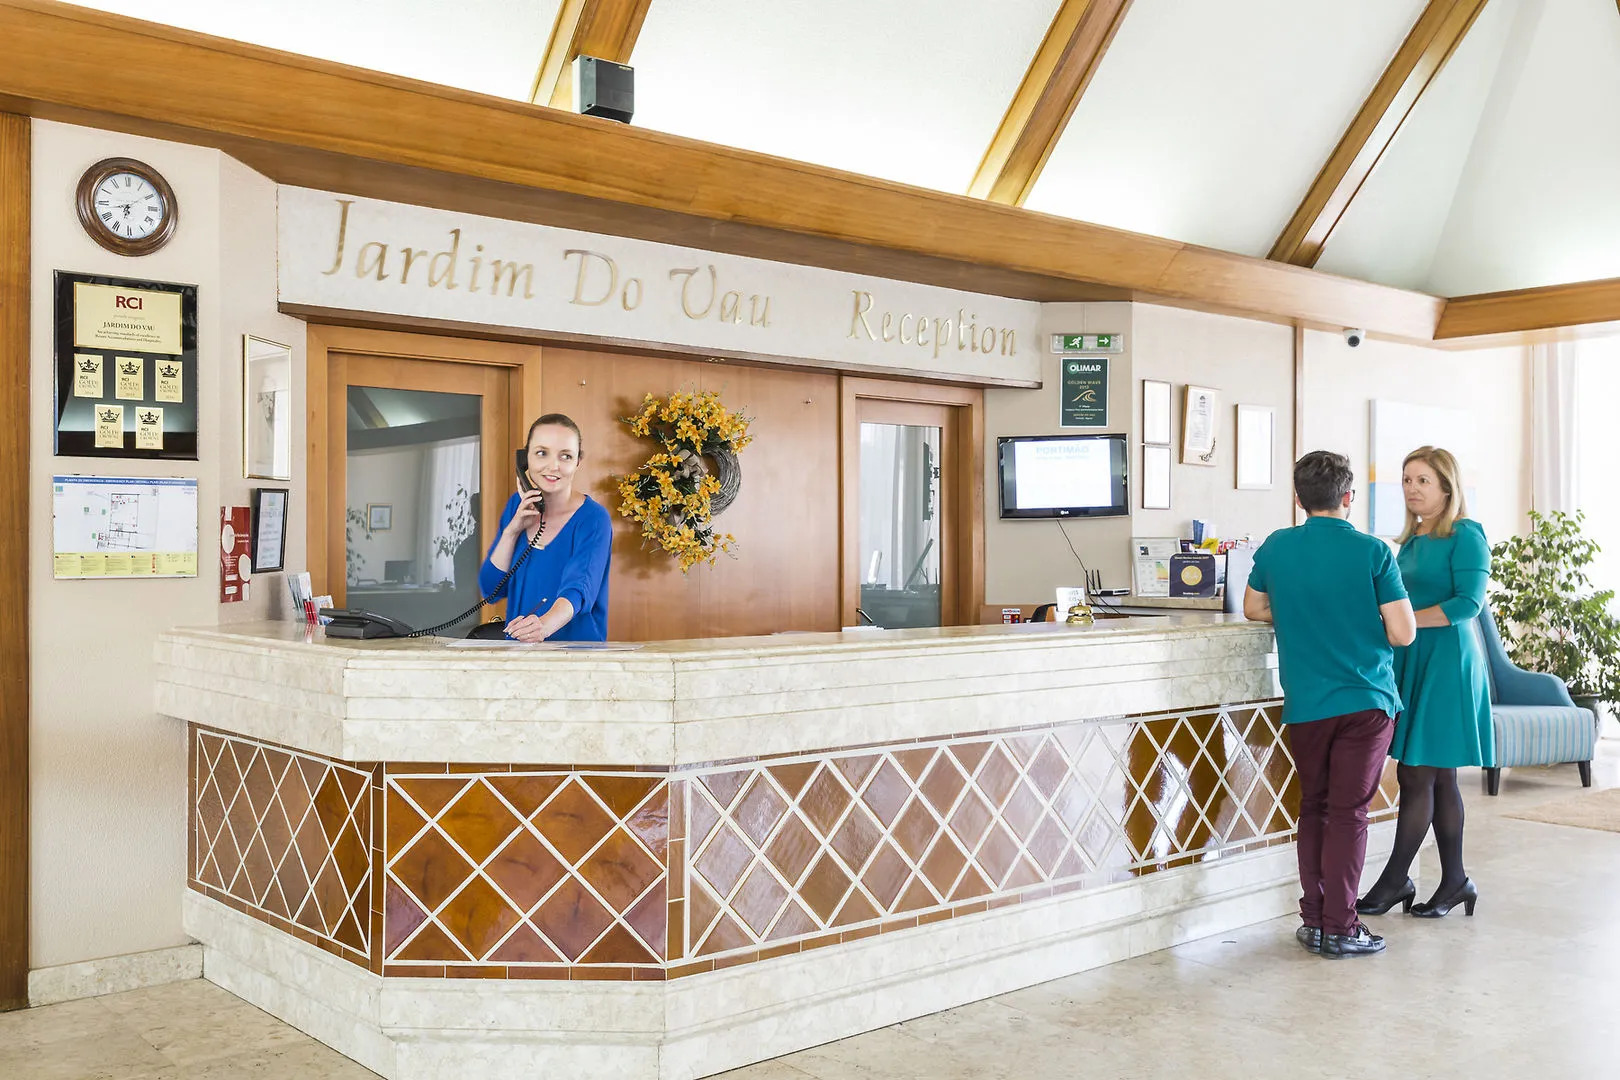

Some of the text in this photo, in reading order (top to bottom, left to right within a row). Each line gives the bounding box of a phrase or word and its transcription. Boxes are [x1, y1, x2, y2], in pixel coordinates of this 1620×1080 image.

[321, 199, 1017, 359] Jardim Do Vau Reception
[115, 295, 143, 310] RCI
[103, 321, 129, 329] JARDIM
[1070, 364, 1102, 372] OLIMAR
